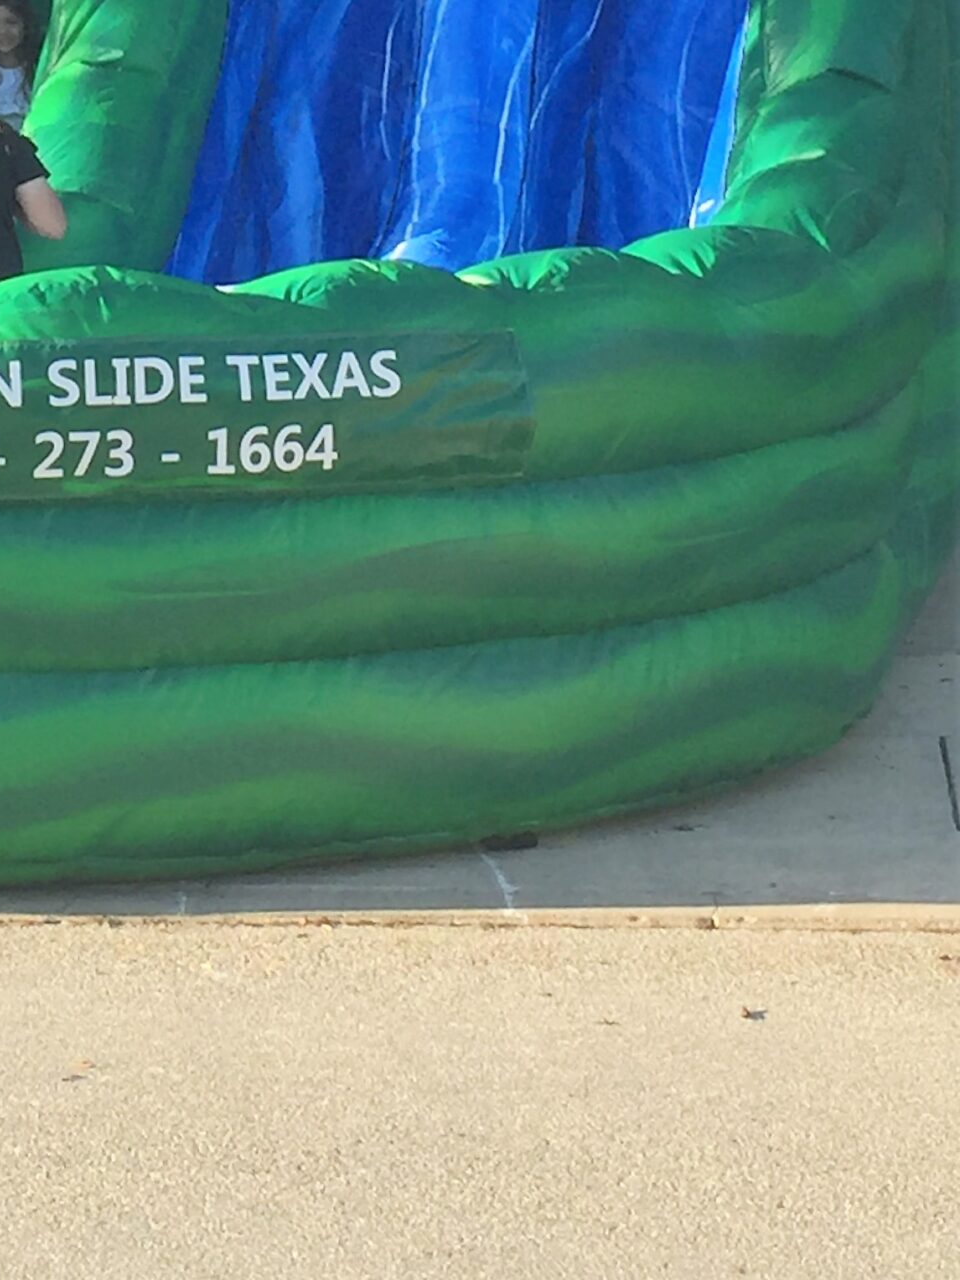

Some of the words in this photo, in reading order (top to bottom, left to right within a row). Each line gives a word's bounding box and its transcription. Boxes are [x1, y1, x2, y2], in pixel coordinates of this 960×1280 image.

[48, 355, 207, 406] SLIDE
[227, 349, 402, 402] TEXAS
[33, 429, 136, 479] 273
[206, 424, 339, 474] 1664
